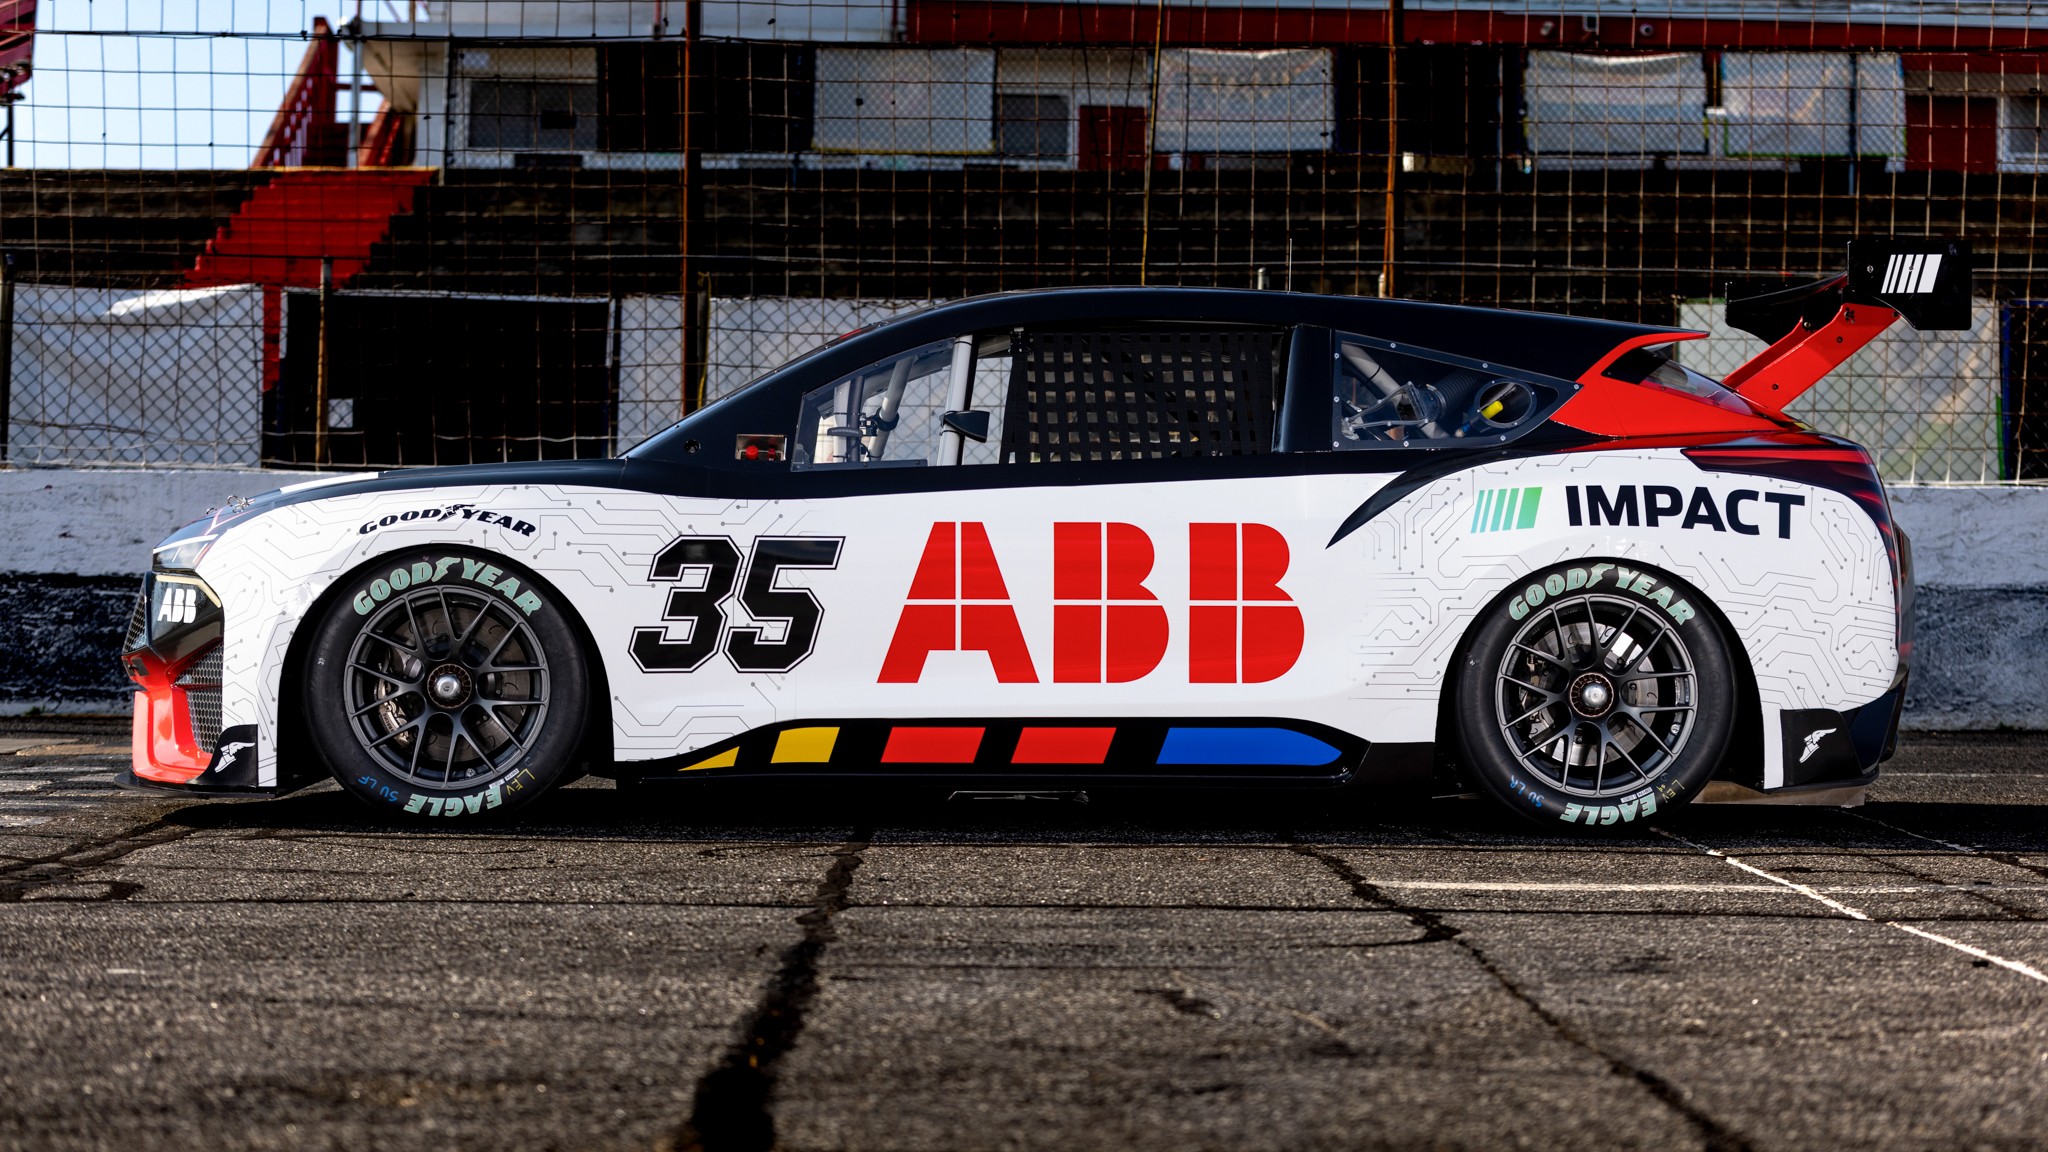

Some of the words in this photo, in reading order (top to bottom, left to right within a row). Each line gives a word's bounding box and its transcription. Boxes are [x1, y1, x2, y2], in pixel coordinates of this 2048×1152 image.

[1565, 485, 1805, 539] IMPACT
[157, 587, 197, 624] ABB
[627, 535, 847, 674] 35
[876, 521, 1306, 684] ABB
[403, 783, 503, 817] EAGLE
[1559, 792, 1658, 826] EAGLE
